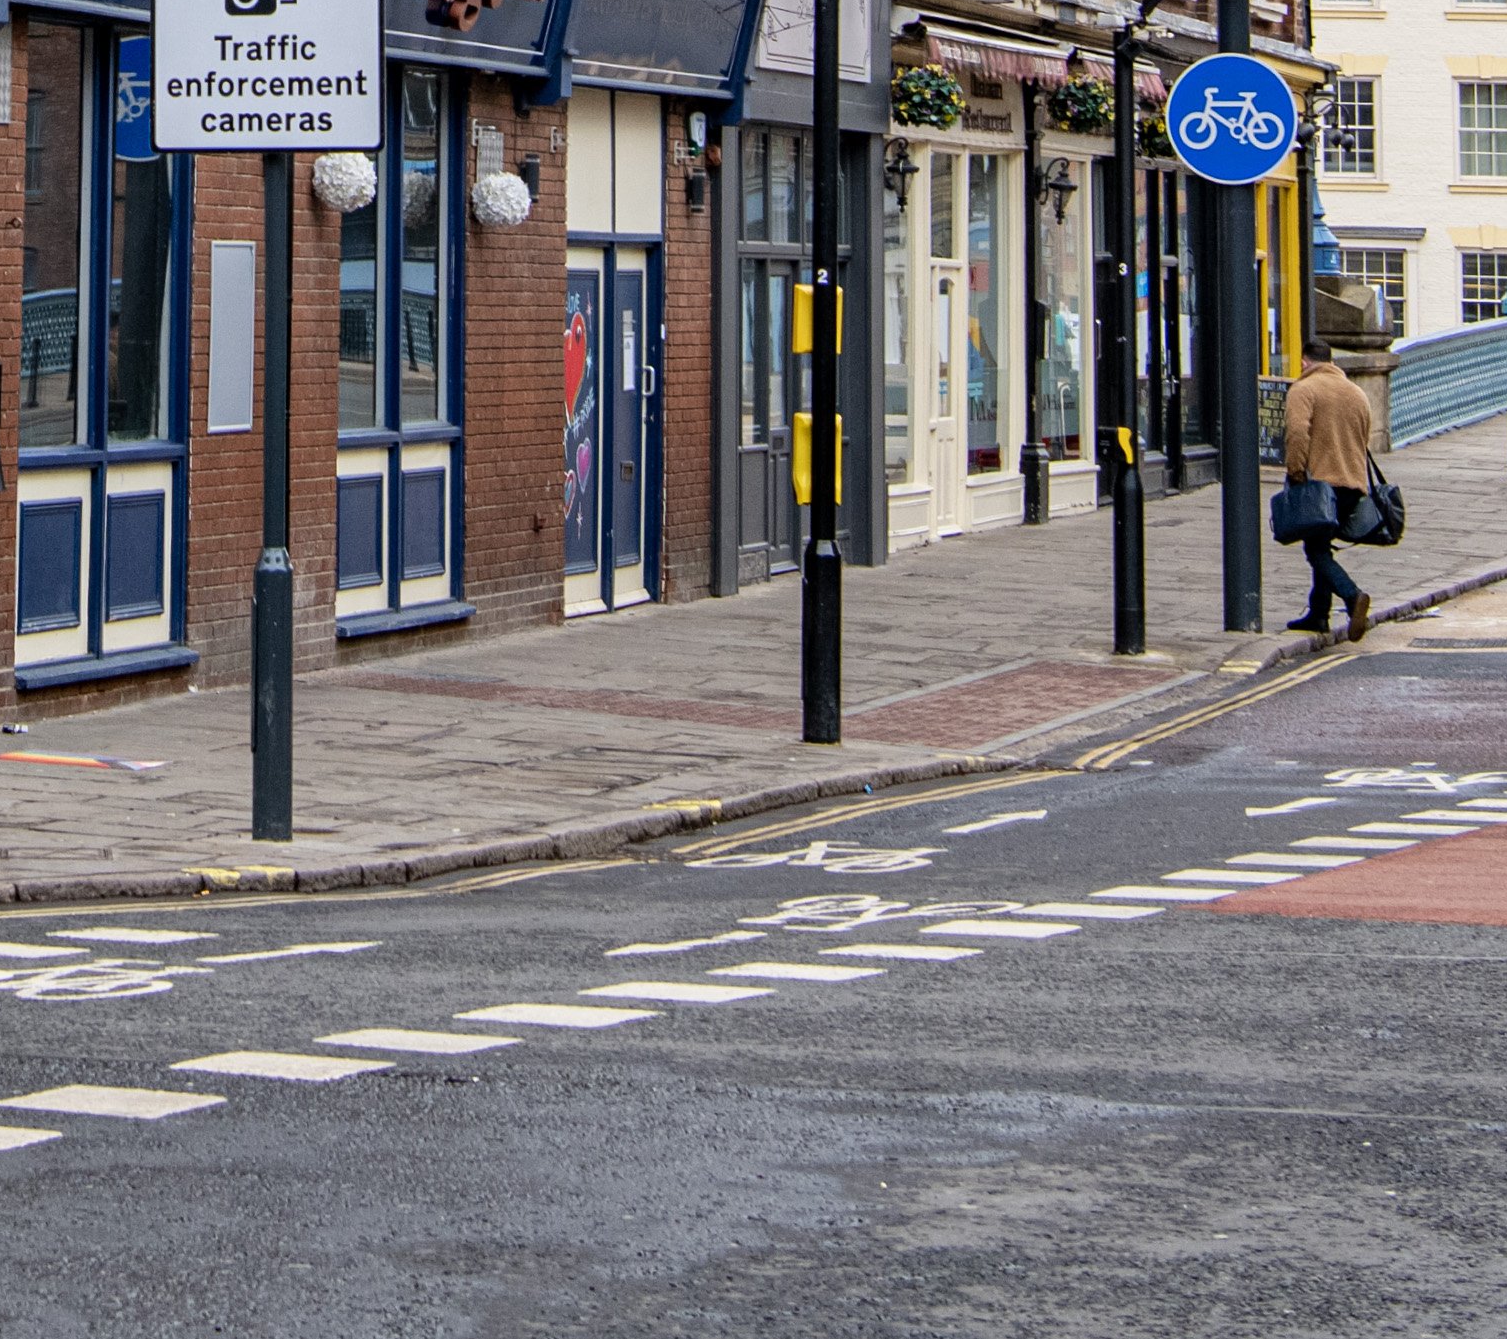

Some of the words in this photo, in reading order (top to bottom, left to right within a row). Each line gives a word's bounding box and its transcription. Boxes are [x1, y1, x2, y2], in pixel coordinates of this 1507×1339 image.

[213, 35, 317, 62] Traffic
[167, 71, 368, 98] enforcement
[200, 109, 334, 133] cameras
[817, 268, 829, 285] 2
[1118, 263, 1128, 276] 3
